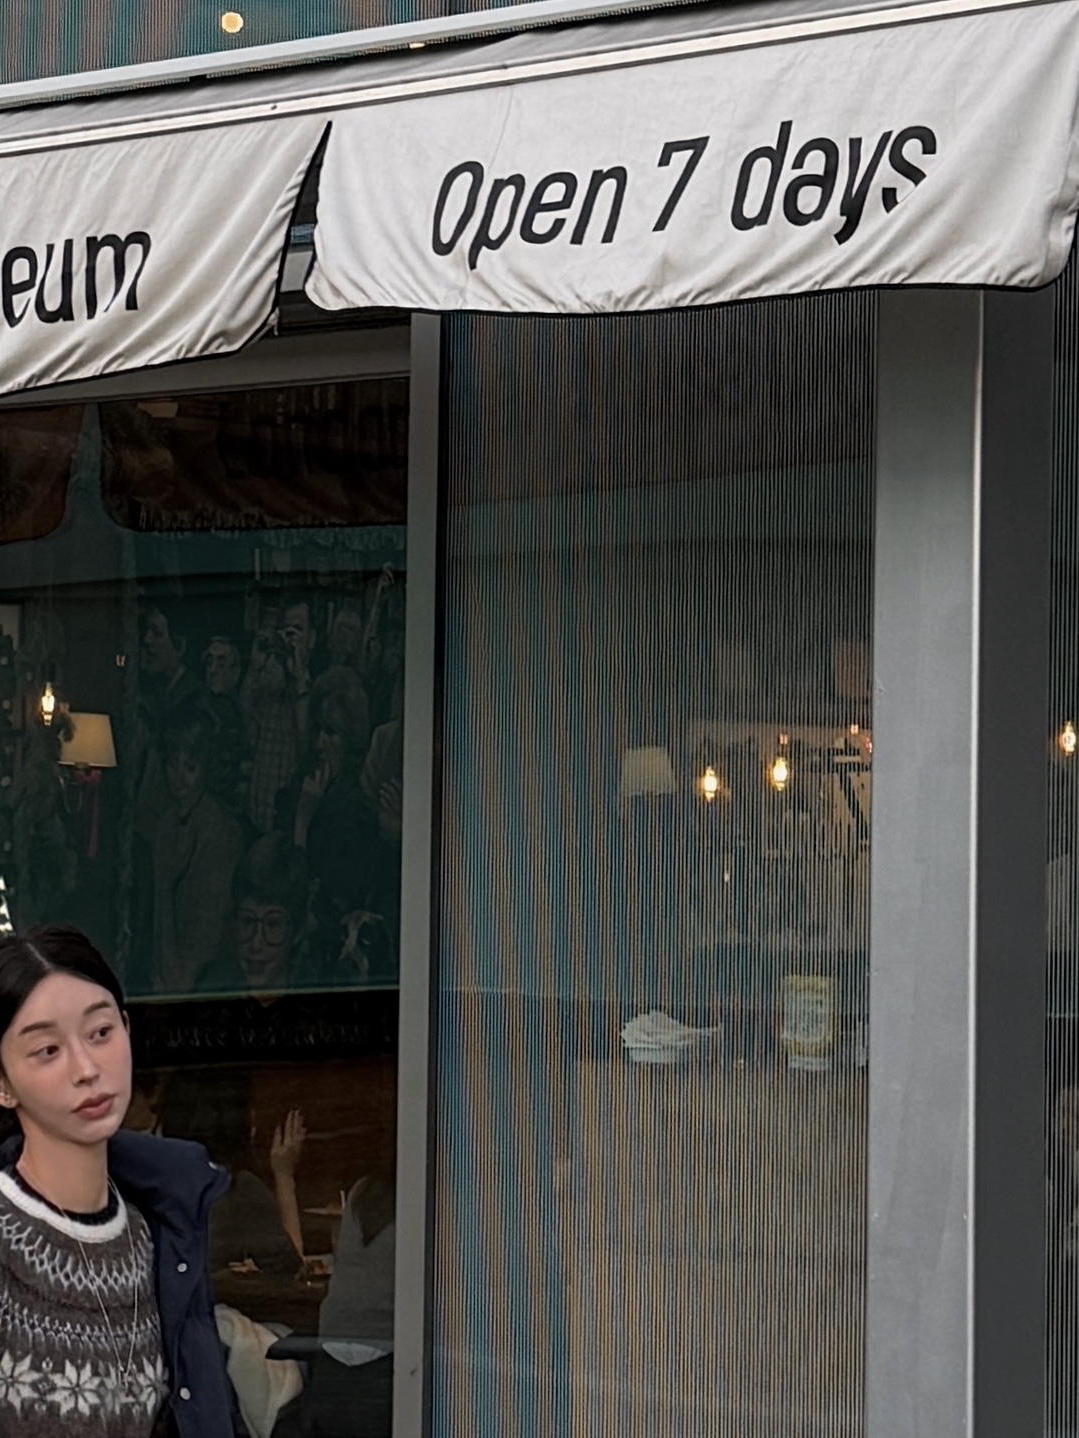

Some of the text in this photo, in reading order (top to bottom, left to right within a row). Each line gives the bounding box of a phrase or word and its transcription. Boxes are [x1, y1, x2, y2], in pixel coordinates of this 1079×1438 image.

[432, 119, 937, 271] Open 7 days
